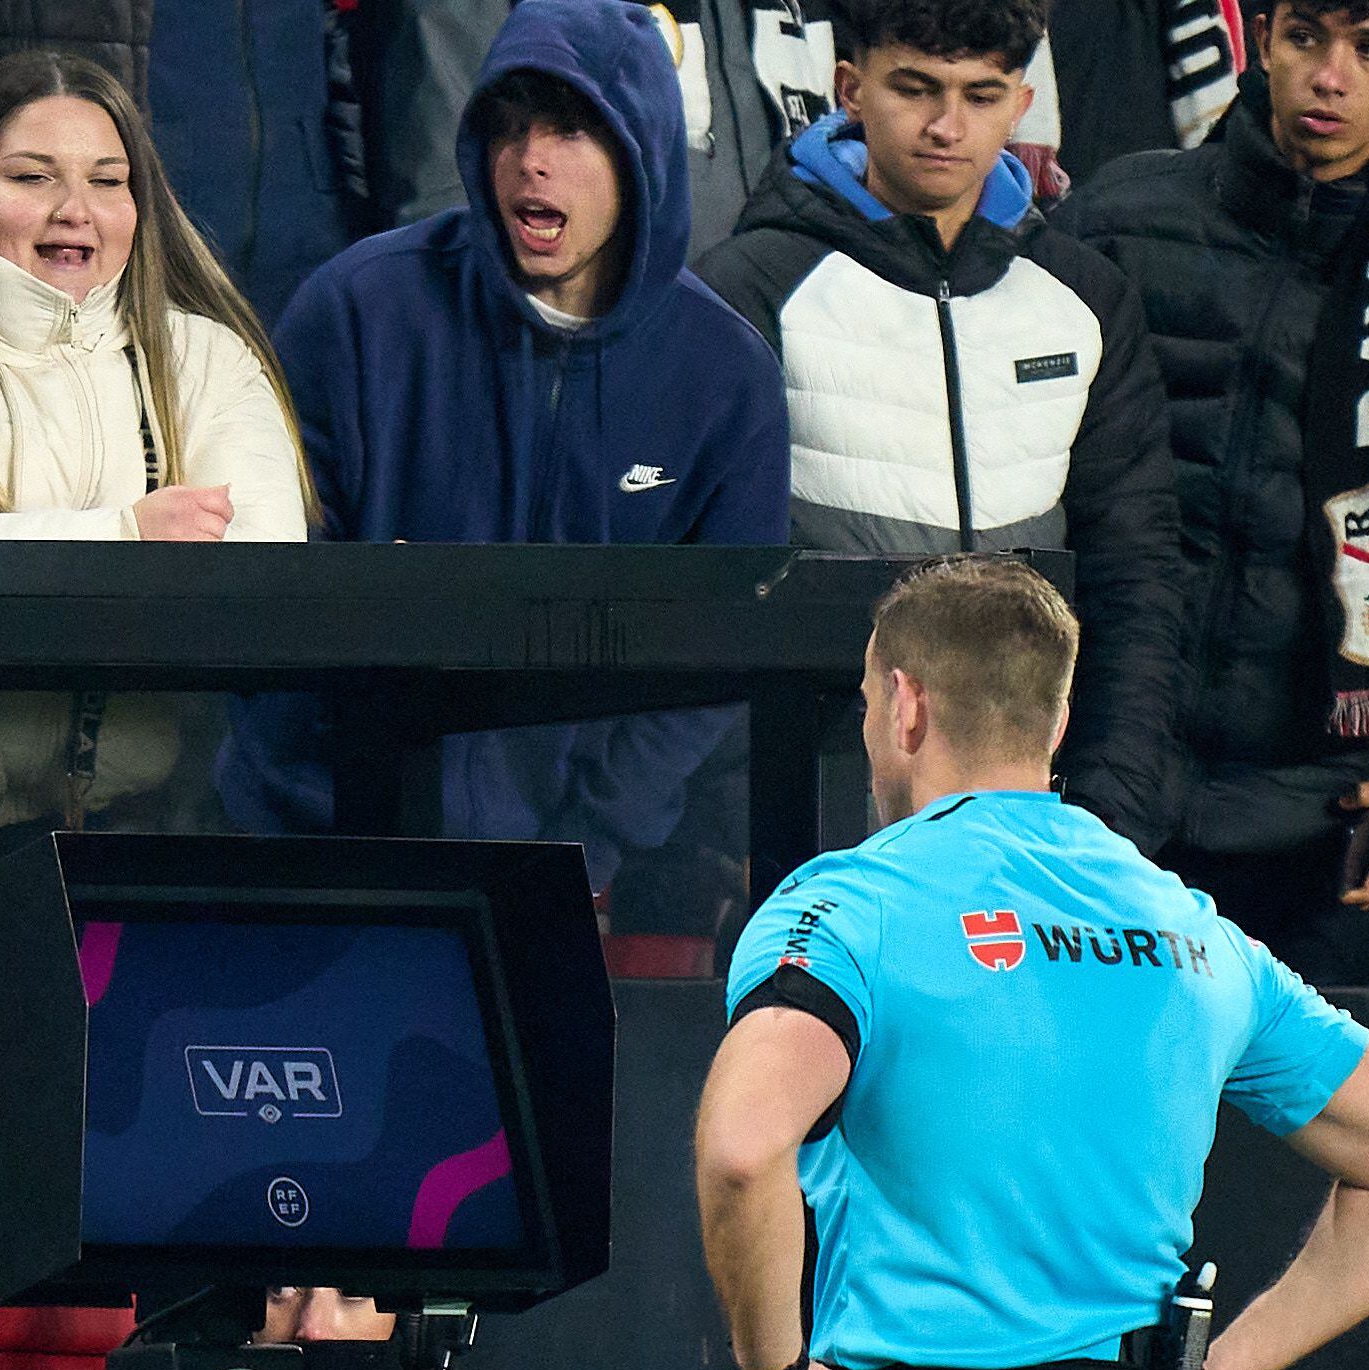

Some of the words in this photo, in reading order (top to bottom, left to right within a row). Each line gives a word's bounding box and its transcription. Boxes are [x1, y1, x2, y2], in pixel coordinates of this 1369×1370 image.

[628, 463, 664, 484] NIKE
[1032, 922, 1215, 979] WÜRTH
[201, 1060, 327, 1101] VAR
